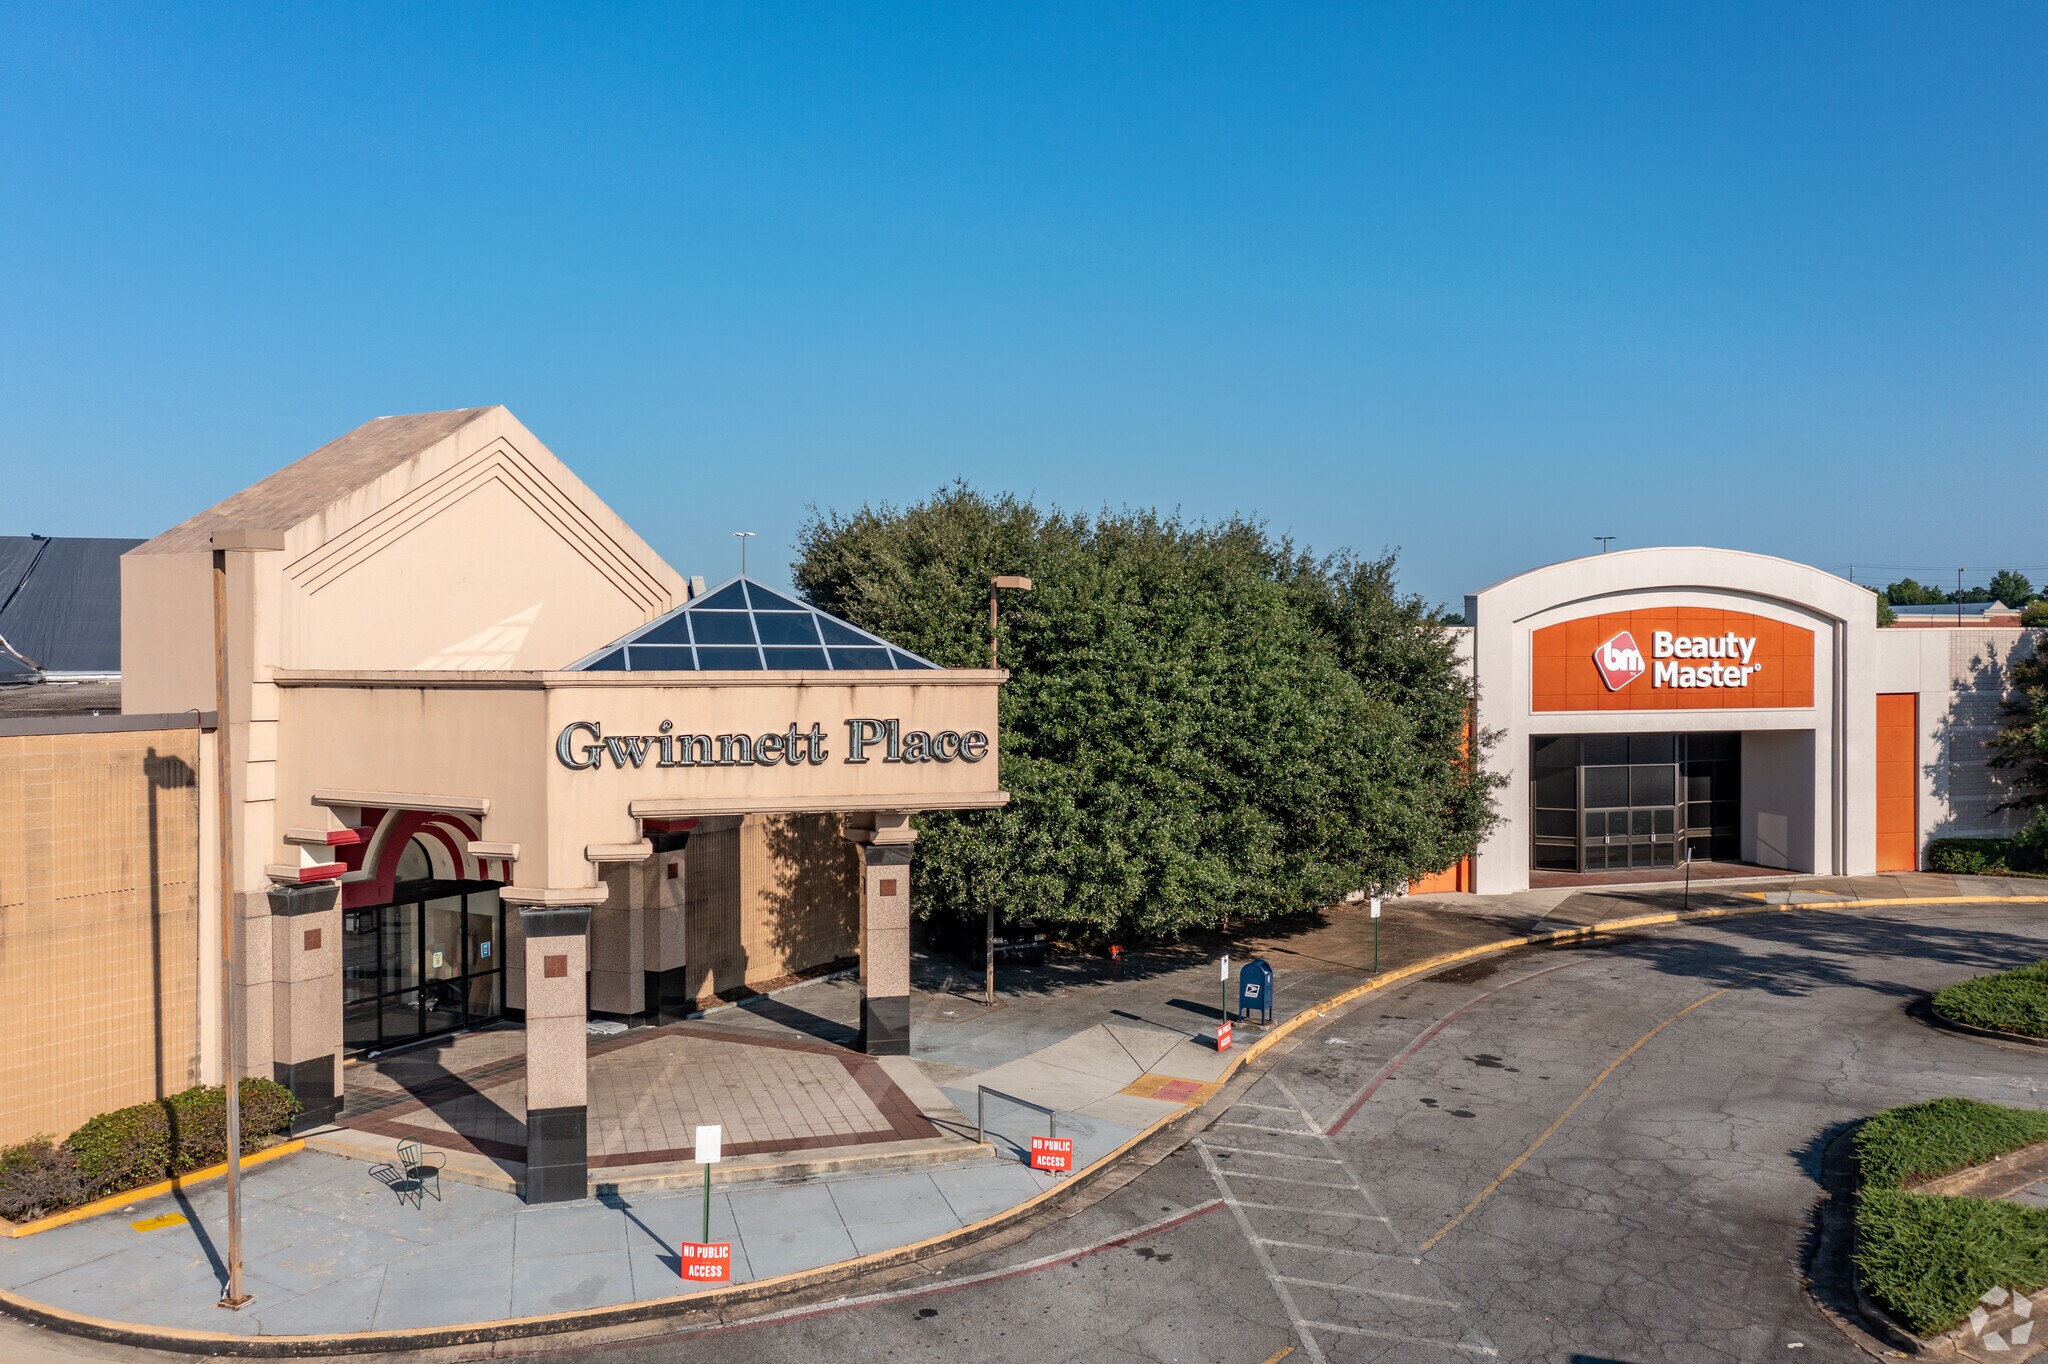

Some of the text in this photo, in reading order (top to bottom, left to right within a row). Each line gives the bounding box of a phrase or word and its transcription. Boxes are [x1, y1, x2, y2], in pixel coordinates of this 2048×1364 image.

[1653, 631, 1757, 664] Beauty
[1653, 661, 1755, 688] Master
[556, 717, 989, 769] Gwinnett Place
[1033, 1139, 1070, 1152] NO PUBLIC
[1037, 1155, 1065, 1167] ACCESS
[683, 1245, 729, 1258] NO PUBLIC
[688, 1264, 723, 1277] ACCESS
